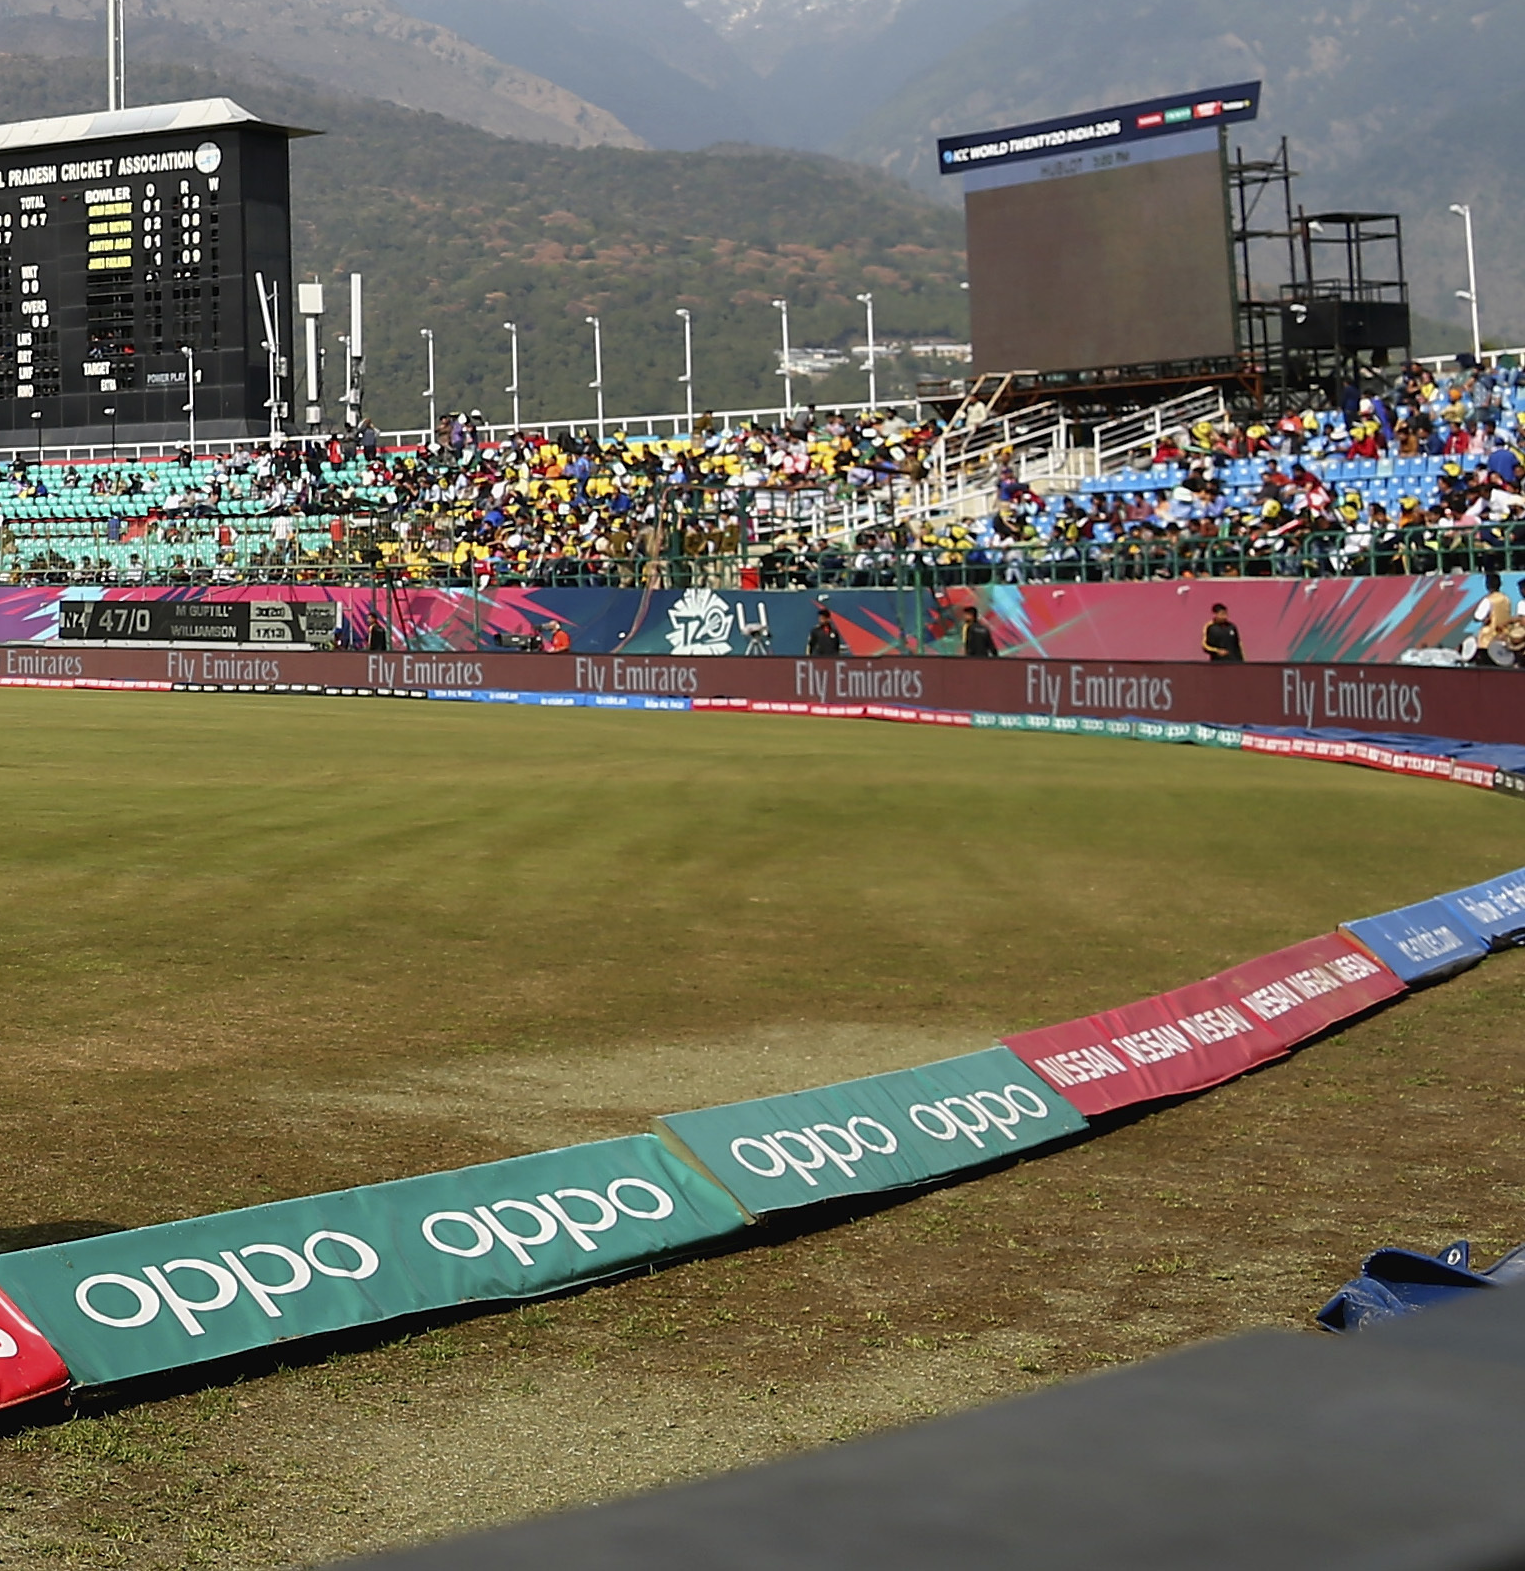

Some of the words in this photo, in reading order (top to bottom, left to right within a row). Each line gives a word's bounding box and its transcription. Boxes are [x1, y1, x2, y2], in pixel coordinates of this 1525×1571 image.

[970, 142, 1009, 160] WORLD
[1009, 130, 1065, 153] TWENTY20
[8, 166, 57, 187] PRADESH
[61, 160, 113, 181] CRICKET
[118, 151, 193, 175] ASSOCIATION
[20, 195, 45, 210] TOTAL
[85, 187, 130, 203] BOWLER
[22, 299, 47, 314] OVERS
[83, 361, 110, 375] TARGET
[147, 373, 169, 384] POWER
[170, 372, 186, 382] PLAY
[99, 609, 150, 635] 47/0
[176, 605, 186, 616] M
[171, 624, 237, 638] WILLIAMSON
[8, 650, 82, 676] Emirates
[168, 652, 195, 683] Fly
[203, 653, 279, 681] Emirates
[368, 655, 395, 688] Fly
[403, 656, 483, 686] Emirates
[576, 657, 606, 692] Fly
[613, 658, 698, 691] Emirates
[795, 660, 829, 703] Fly
[836, 662, 923, 699] Emirates
[1026, 664, 1061, 715] Fly
[1070, 666, 1172, 710] Emirates
[1282, 668, 1315, 730] Fly
[1324, 669, 1422, 723] Emirates
[1034, 1044, 1128, 1088] NISSAN
[1112, 1024, 1194, 1067] NISSAN
[1178, 1004, 1254, 1045] NISSAN
[1241, 980, 1303, 1021] NISSAN
[1285, 966, 1343, 999] NISSAN
[1325, 952, 1380, 983] NISSAN
[730, 1116, 898, 1186] oppo
[909, 1083, 1049, 1149] oppo
[74, 1230, 379, 1337] oppo
[422, 1177, 675, 1267] oppo
